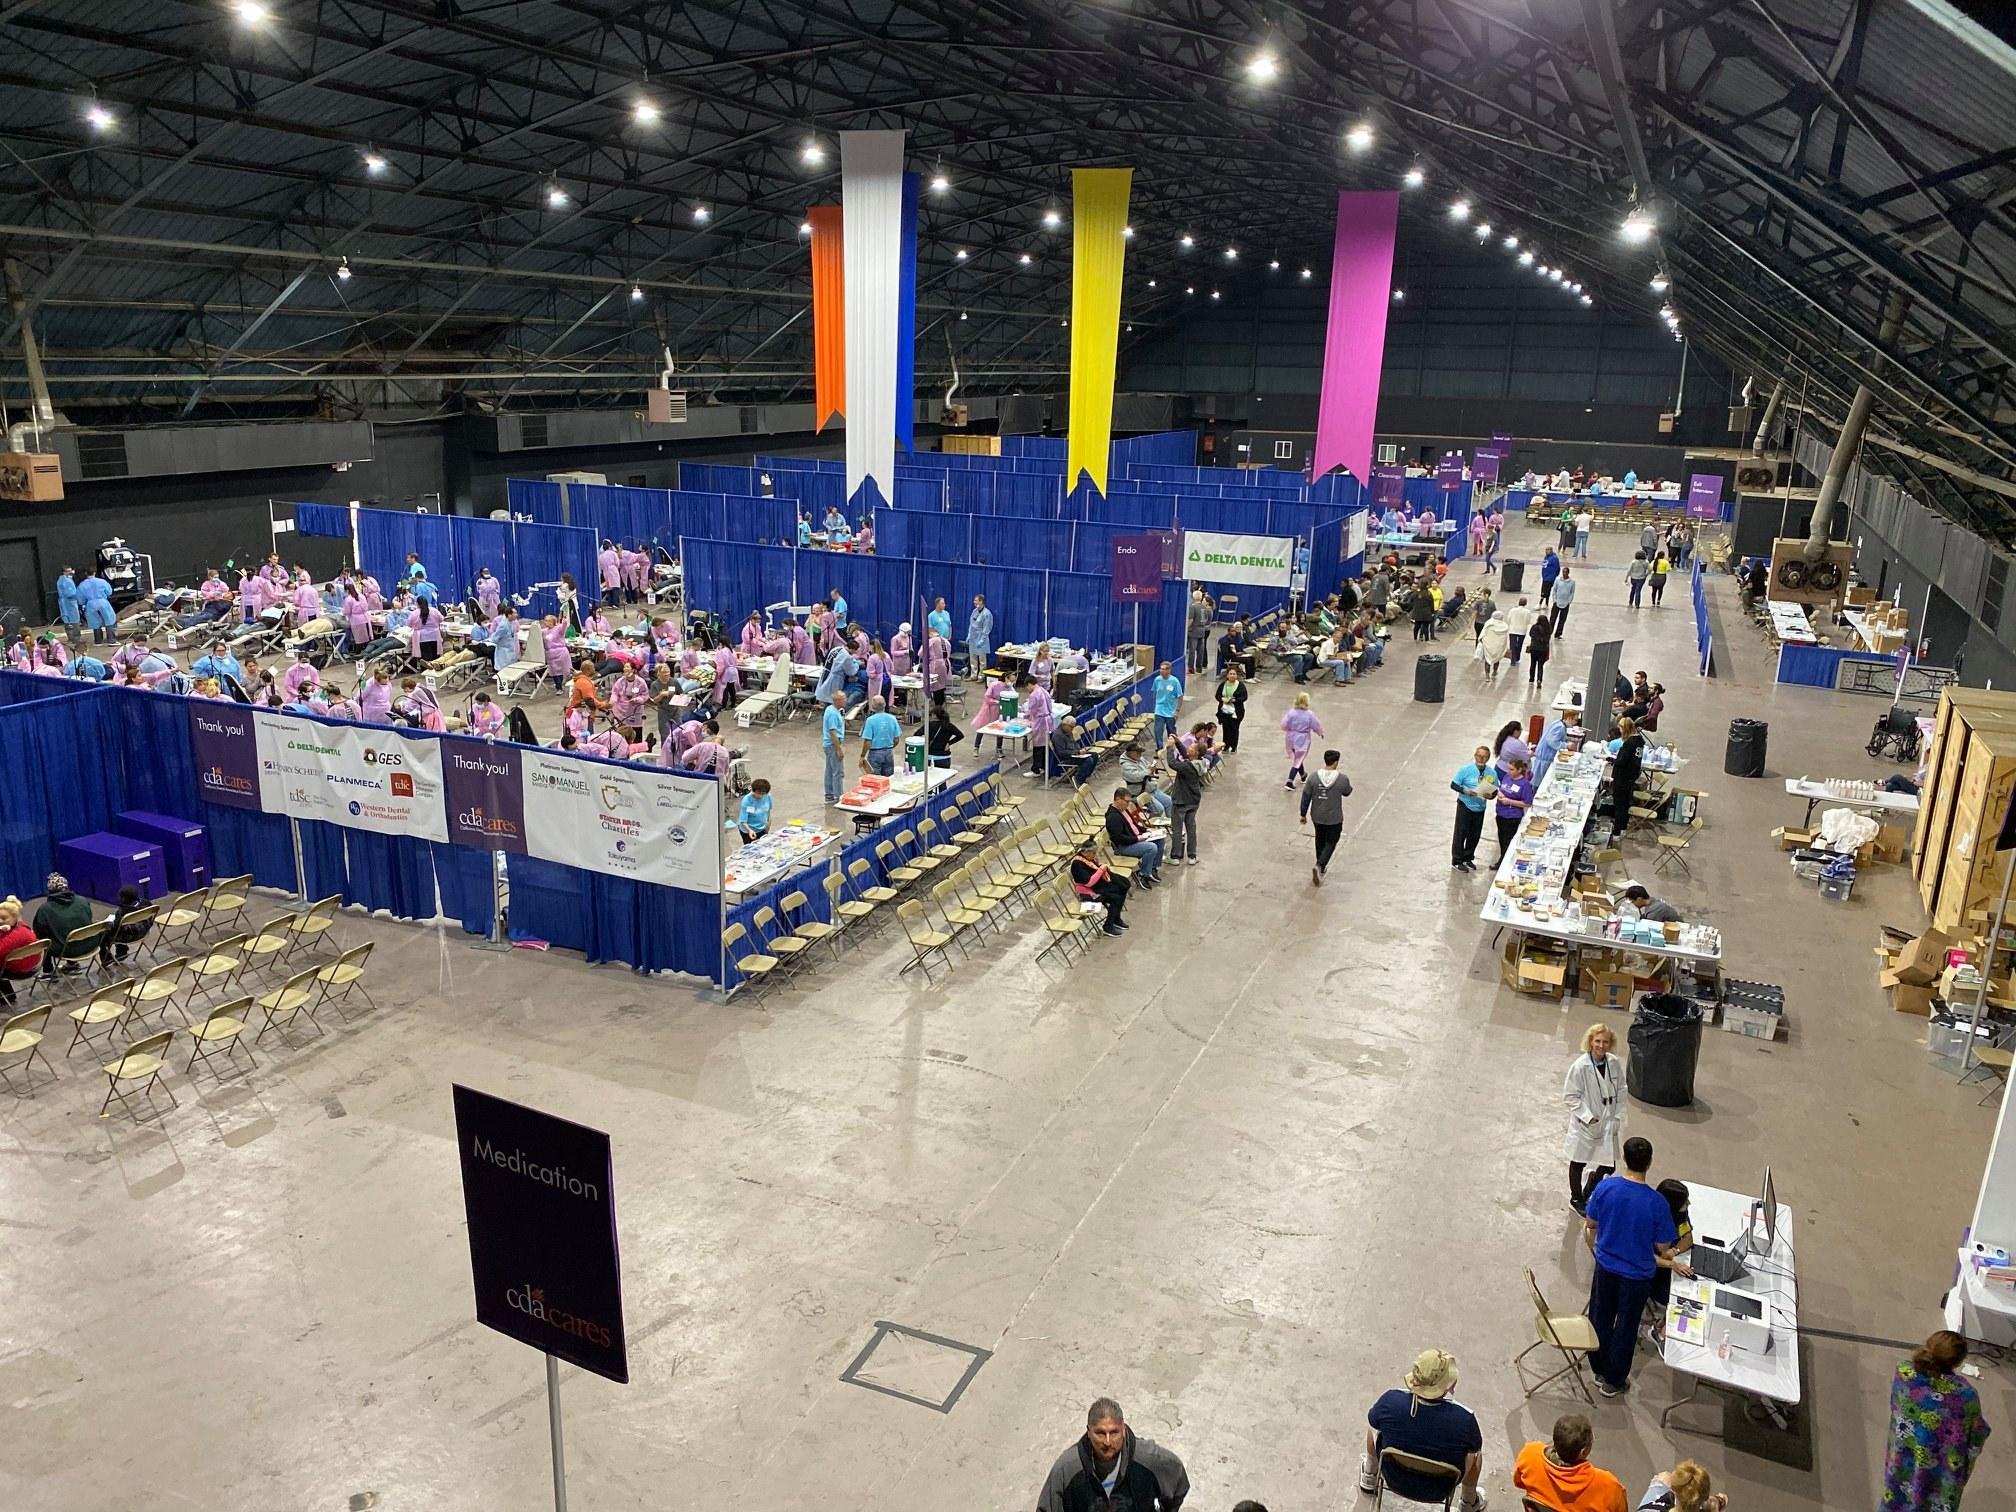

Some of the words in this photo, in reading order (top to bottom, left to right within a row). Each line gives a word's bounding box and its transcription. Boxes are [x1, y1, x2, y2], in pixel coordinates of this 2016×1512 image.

[1117, 546, 1137, 554] Endo
[1205, 553, 1237, 565] DELTA
[1240, 556, 1285, 568] DENTAL
[196, 717, 223, 733] Thank
[225, 723, 245, 737] you!
[379, 752, 402, 765] GES
[453, 755, 485, 771] Thank
[485, 762, 509, 776] you!
[203, 767, 224, 785] cda
[224, 775, 253, 790] cares
[326, 774, 382, 790] PLANMECA
[531, 772, 549, 784] SAN
[556, 777, 590, 791] MANUEL
[656, 783, 672, 791] Silver
[360, 802, 386, 812] Western
[387, 806, 411, 815] Dental
[459, 807, 482, 827] cda
[482, 817, 517, 833] cares
[599, 813, 622, 825] STATER
[601, 821, 640, 837] Charities
[473, 1135, 599, 1201] Medication
[506, 1284, 545, 1322] cda
[546, 1305, 611, 1348] cares
